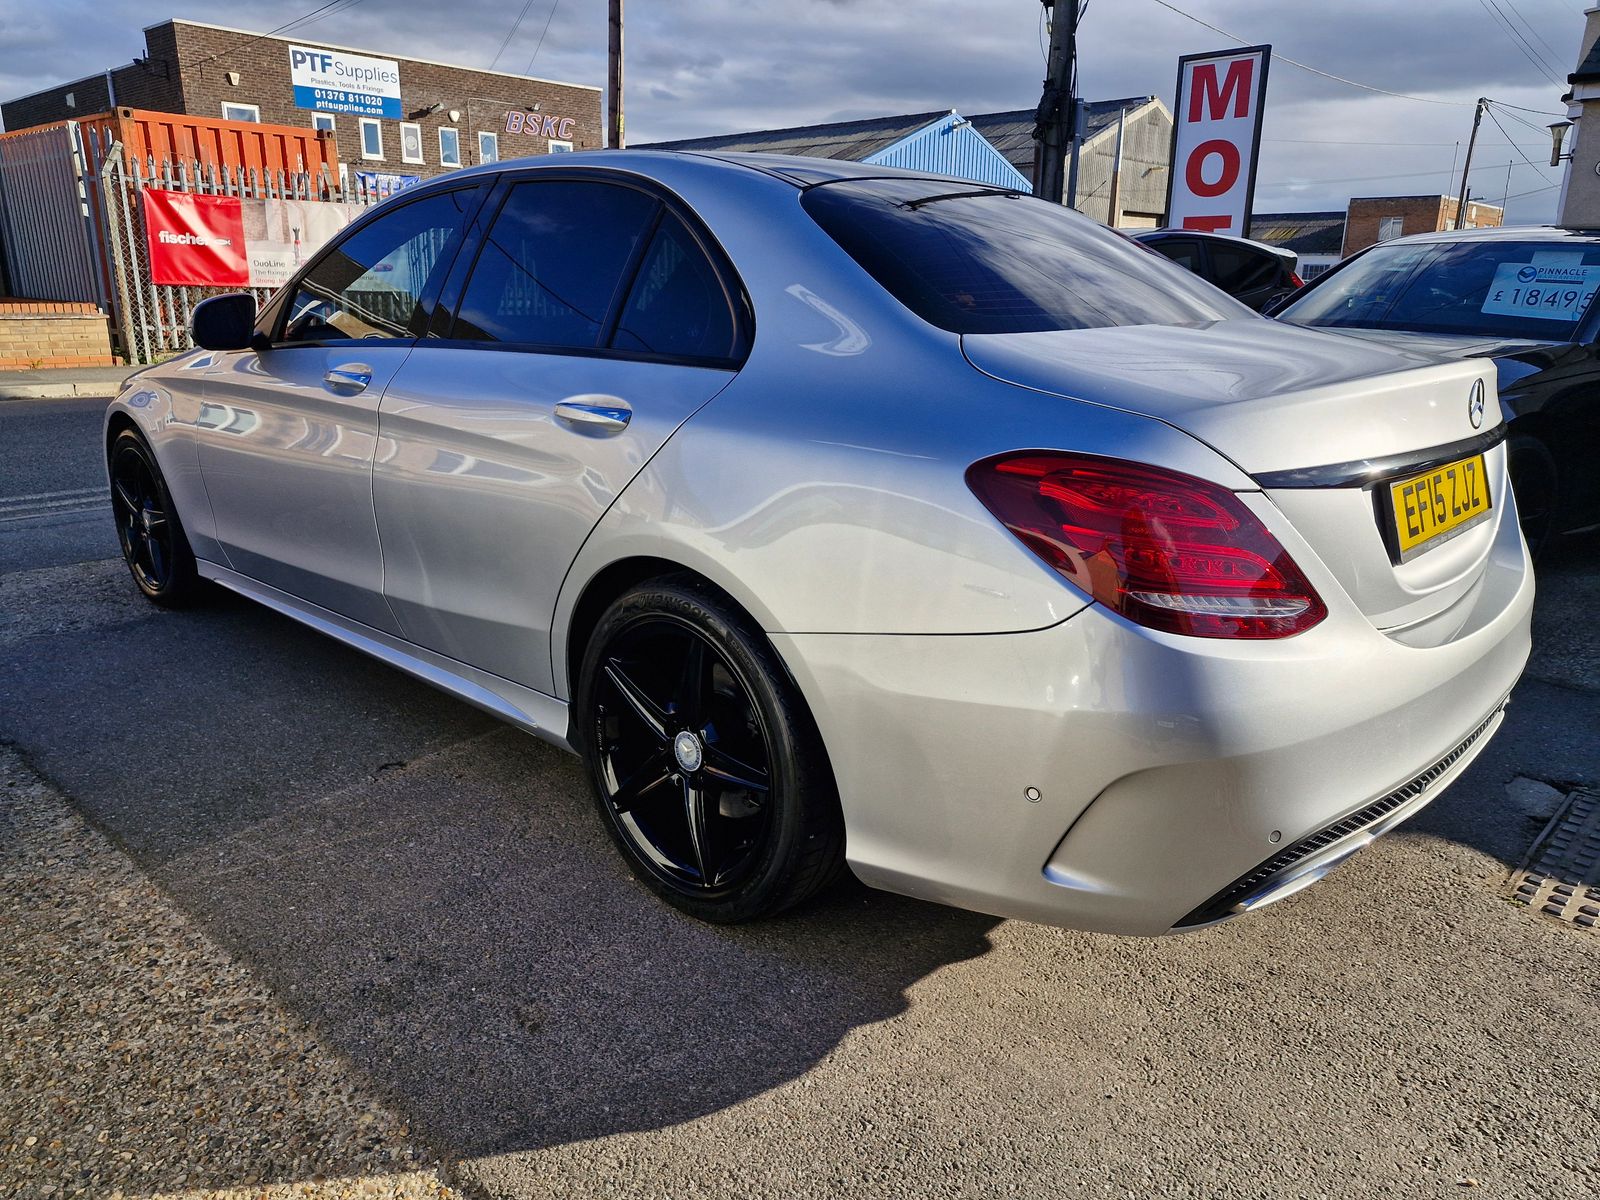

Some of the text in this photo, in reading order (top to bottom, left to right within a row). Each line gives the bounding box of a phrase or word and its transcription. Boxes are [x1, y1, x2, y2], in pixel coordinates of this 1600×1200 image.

[291, 49, 398, 84] PTF Supplies
[339, 82, 355, 90] Tools
[362, 85, 384, 94] Fixings
[314, 89, 383, 106] 01376 811020
[316, 101, 384, 115] ptfsupplies.com
[505, 110, 576, 139] BSKC
[253, 259, 286, 268] DuoLine
[1538, 267, 1588, 277] PINNACLE
[1402, 474, 1447, 539] EF15
[1446, 461, 1480, 518] ZJZ
